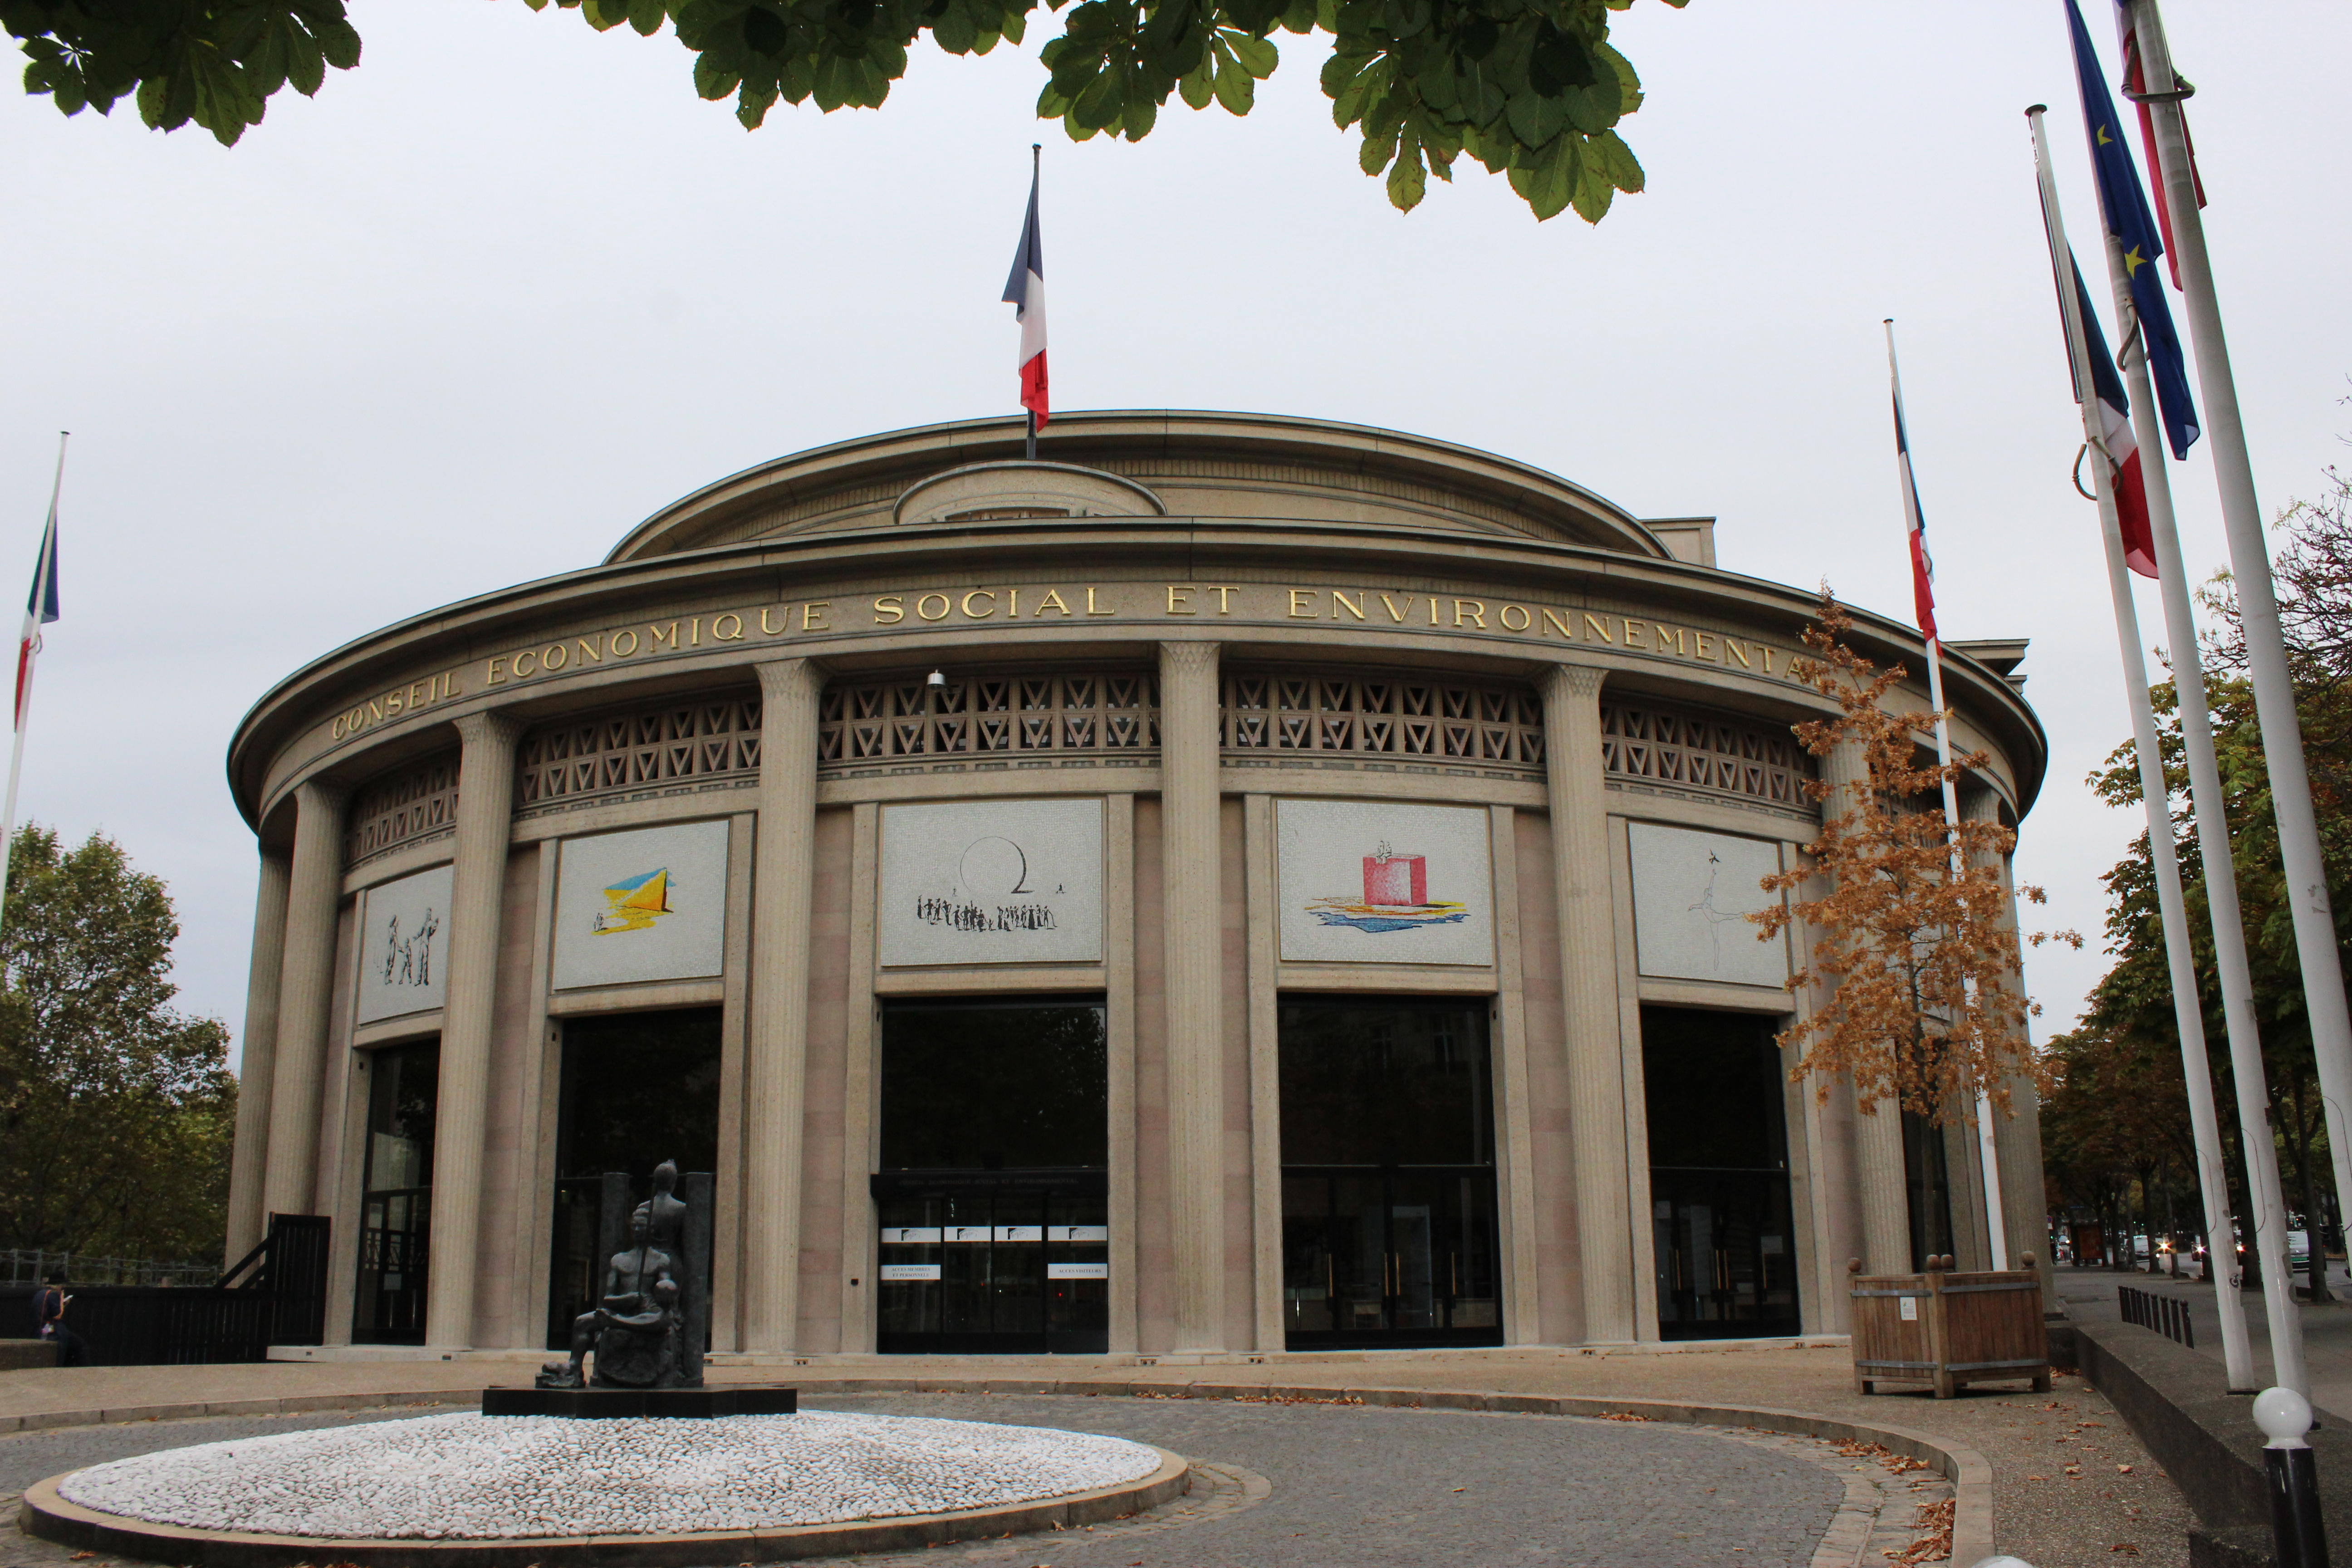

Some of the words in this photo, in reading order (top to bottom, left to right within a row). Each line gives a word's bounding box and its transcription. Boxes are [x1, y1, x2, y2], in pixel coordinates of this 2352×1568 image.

[332, 672, 461, 740] CONSEIL
[487, 602, 831, 685] ECONOMIQUE
[874, 587, 1115, 623] SOCIAL
[1167, 586, 1239, 614] ET
